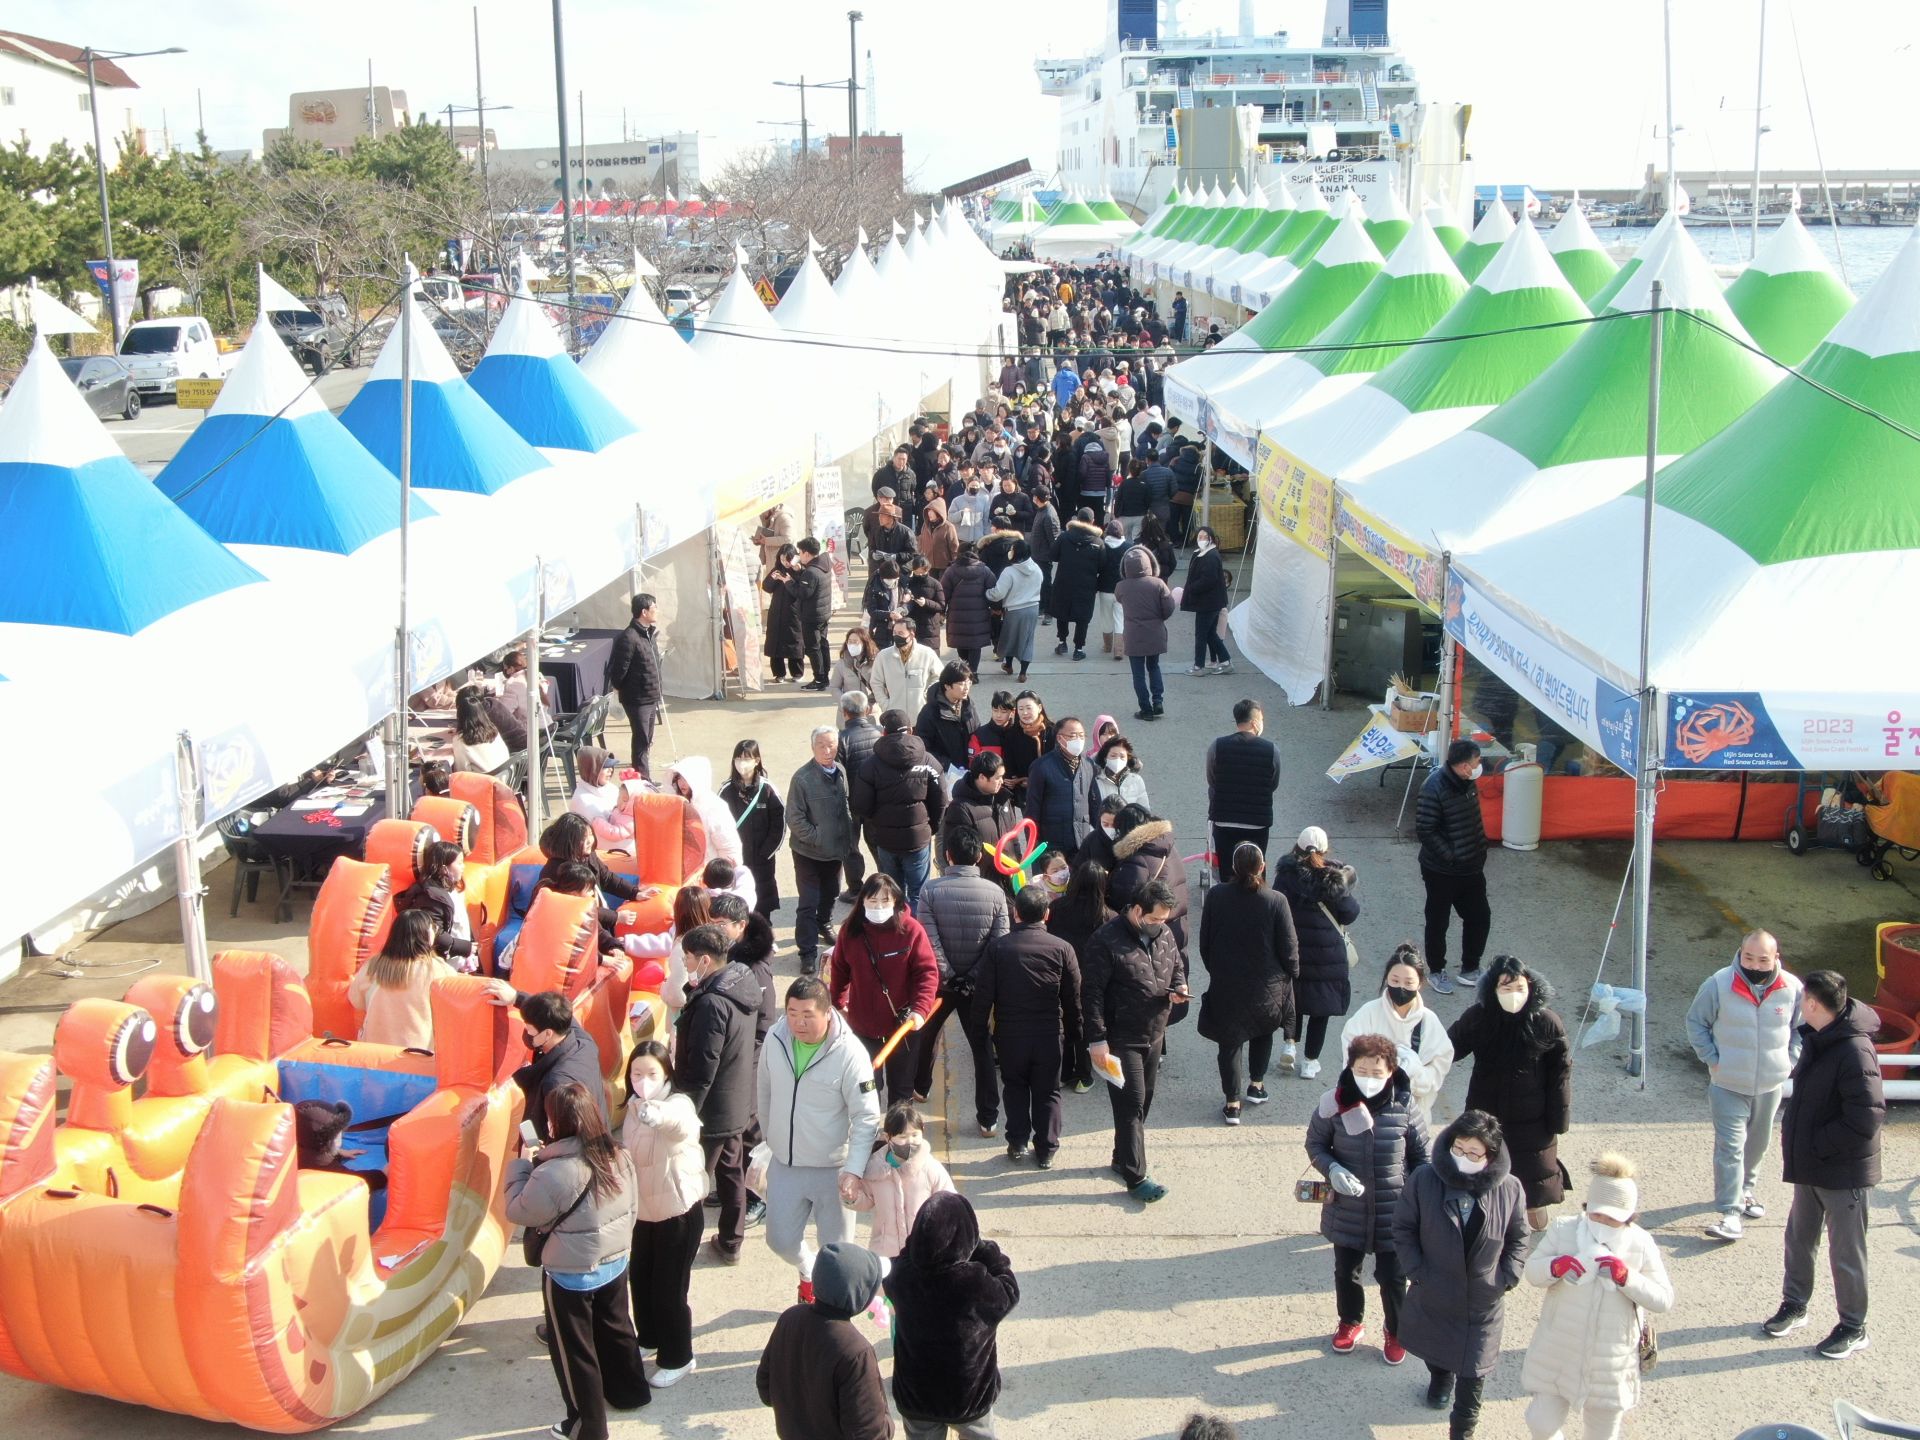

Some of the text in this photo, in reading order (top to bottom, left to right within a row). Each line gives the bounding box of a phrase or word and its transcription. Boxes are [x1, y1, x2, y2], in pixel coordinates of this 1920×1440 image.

[1315, 165, 1354, 174] ULLEUNG
[1319, 184, 1356, 193] ANAMA
[1803, 719, 1853, 734] 2023
